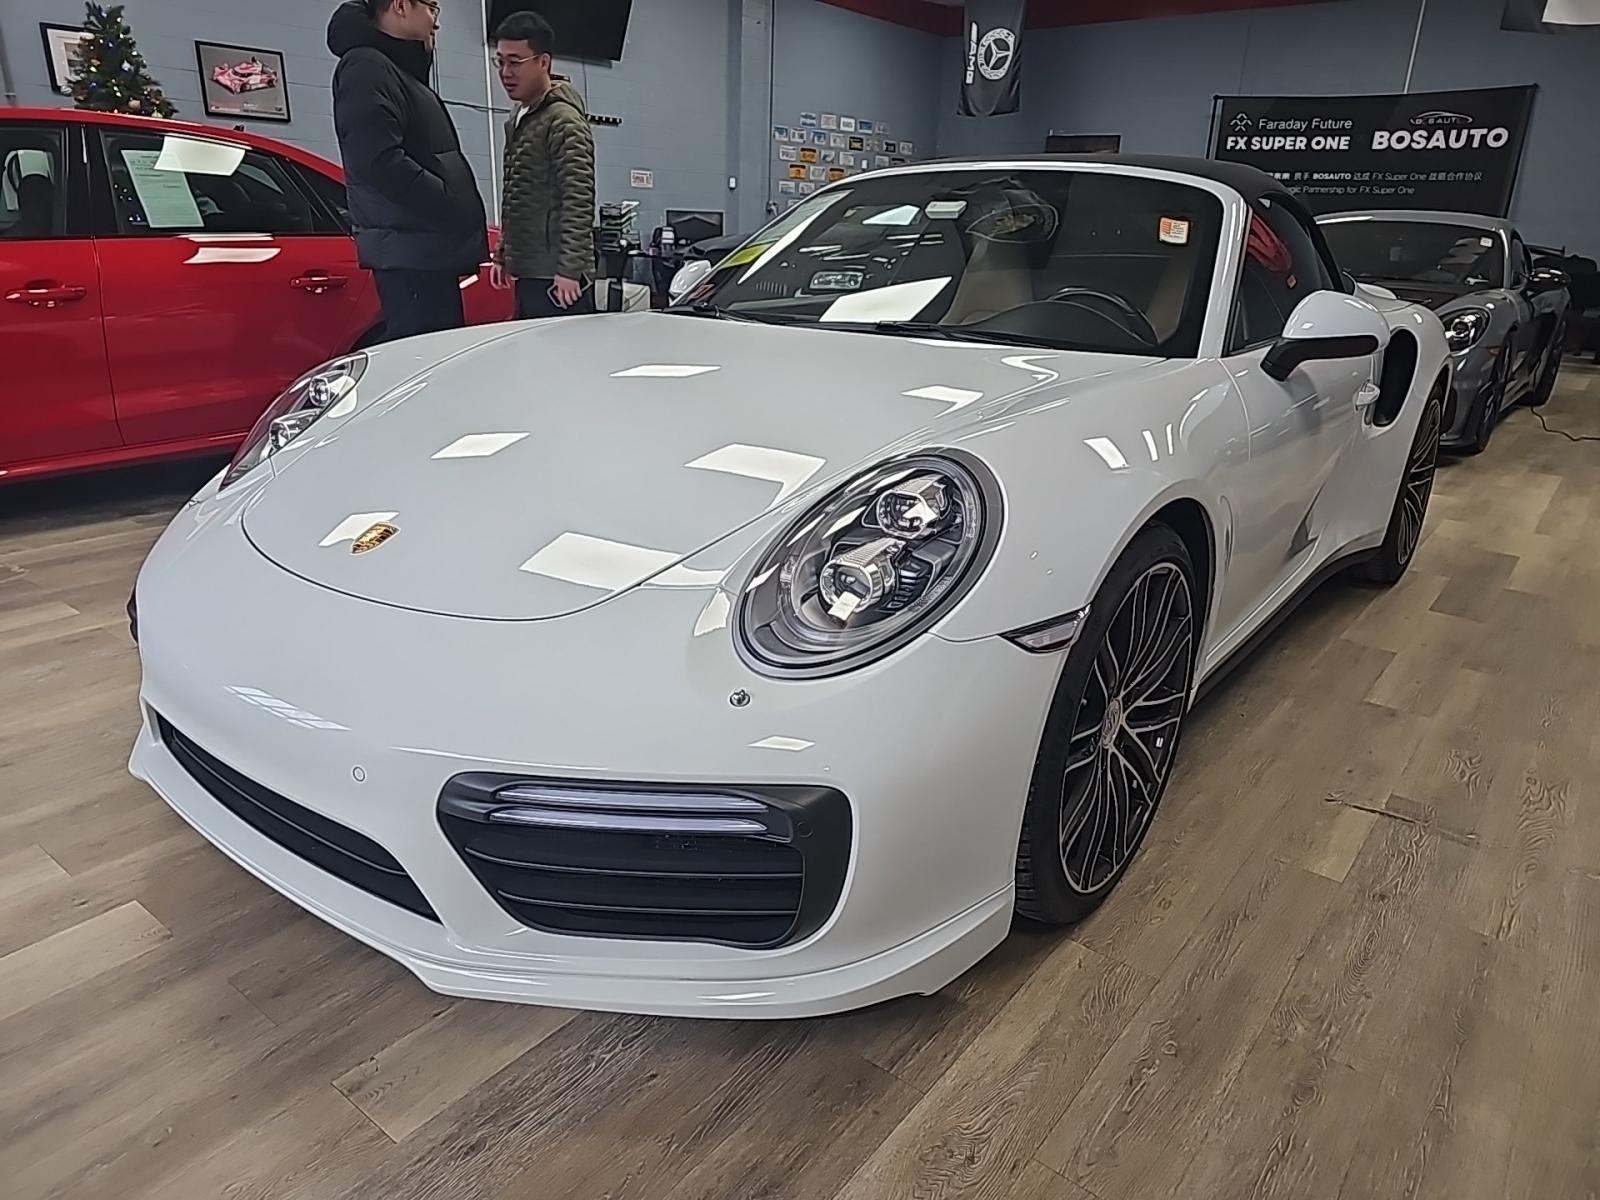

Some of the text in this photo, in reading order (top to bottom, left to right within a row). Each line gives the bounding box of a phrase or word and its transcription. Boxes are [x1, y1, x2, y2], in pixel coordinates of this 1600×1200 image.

[1259, 118, 1353, 132] Faraday Future
[1226, 136, 1351, 150] FX SUPER ONE
[1371, 127, 1509, 150] BOSAUTO
[1312, 172, 1352, 180] BOSAUTO
[1409, 172, 1428, 180] One
[1359, 186, 1371, 194] FX
[1371, 185, 1396, 195] Super
[1397, 185, 1415, 194] One
